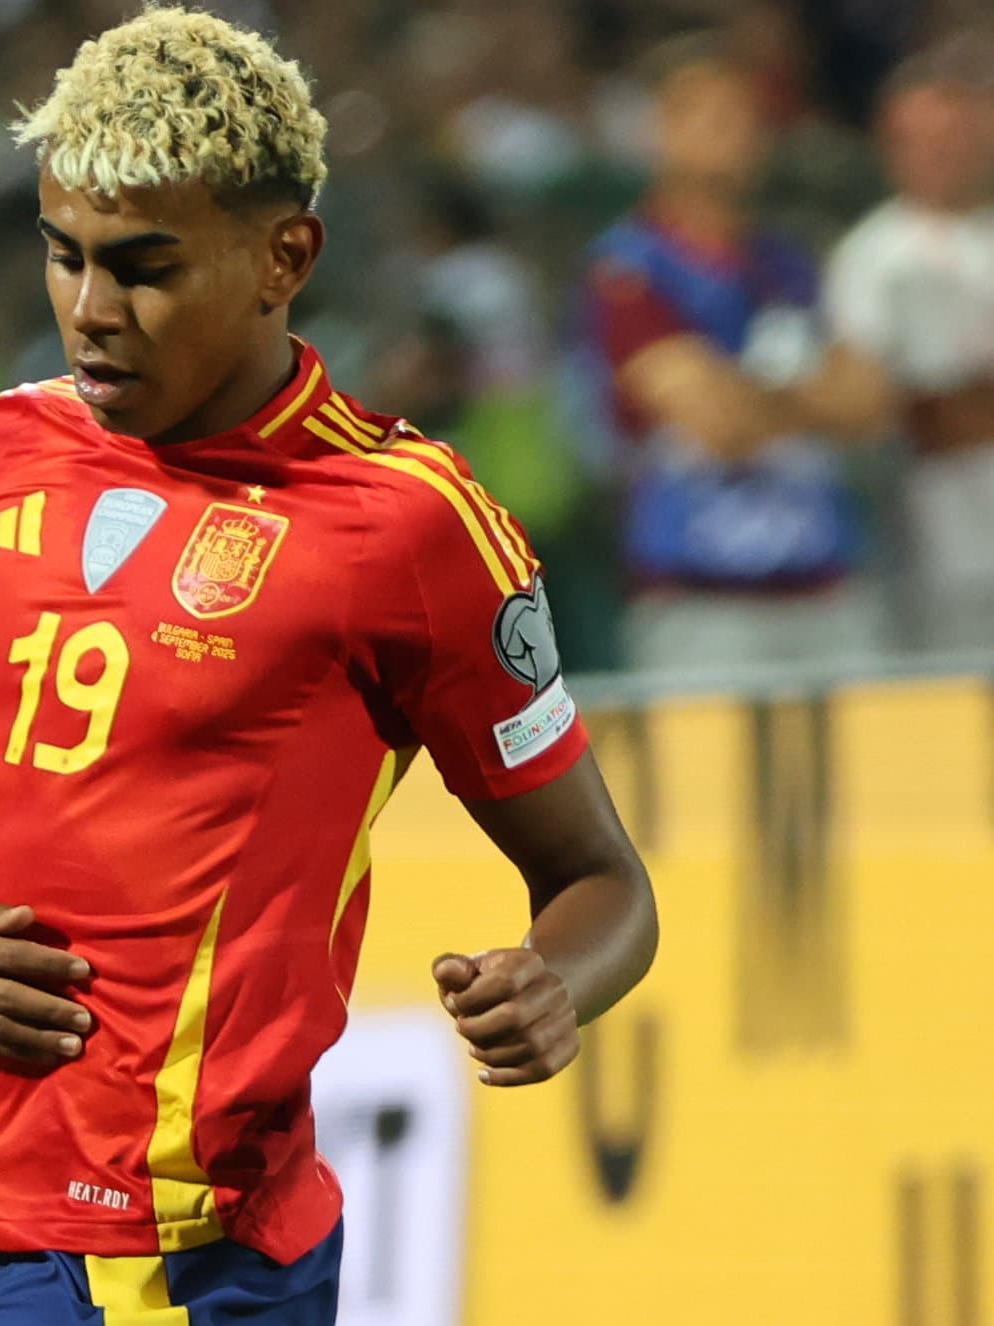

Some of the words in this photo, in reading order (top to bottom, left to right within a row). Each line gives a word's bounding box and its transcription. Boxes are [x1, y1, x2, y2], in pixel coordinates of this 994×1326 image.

[157, 621, 199, 641] BULGARIA
[206, 634, 234, 649] SPAIN
[159, 632, 210, 655] SEPTEMBER
[211, 645, 237, 660] 2025
[174, 647, 202, 663] SOFIA
[4, 611, 130, 775] 19
[67, 1180, 130, 1210] HEAT.RDY
